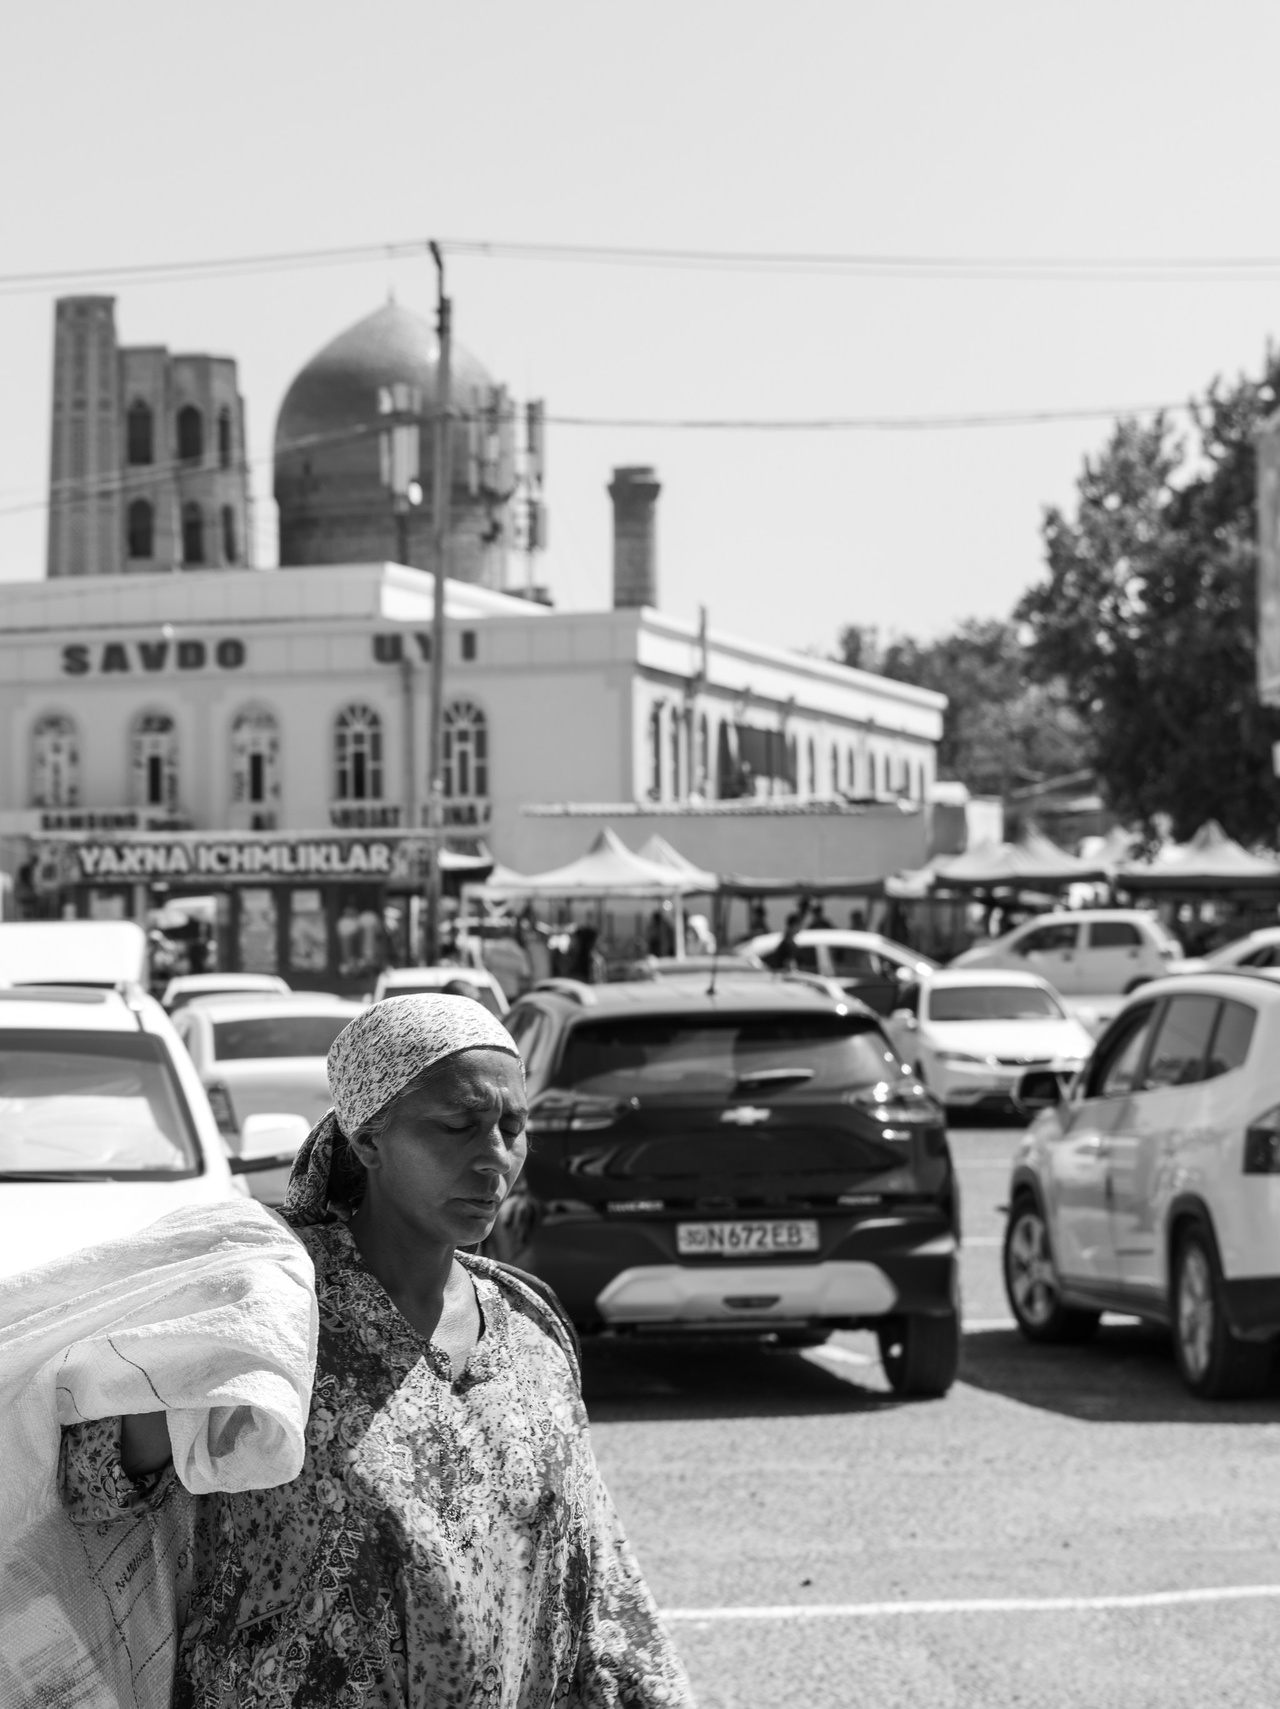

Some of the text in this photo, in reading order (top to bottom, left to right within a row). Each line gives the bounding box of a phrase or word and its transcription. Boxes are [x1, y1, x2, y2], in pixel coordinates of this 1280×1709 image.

[61, 638, 247, 676] SAVDO
[79, 842, 391, 874] YAXNA ICHMLIKLAR
